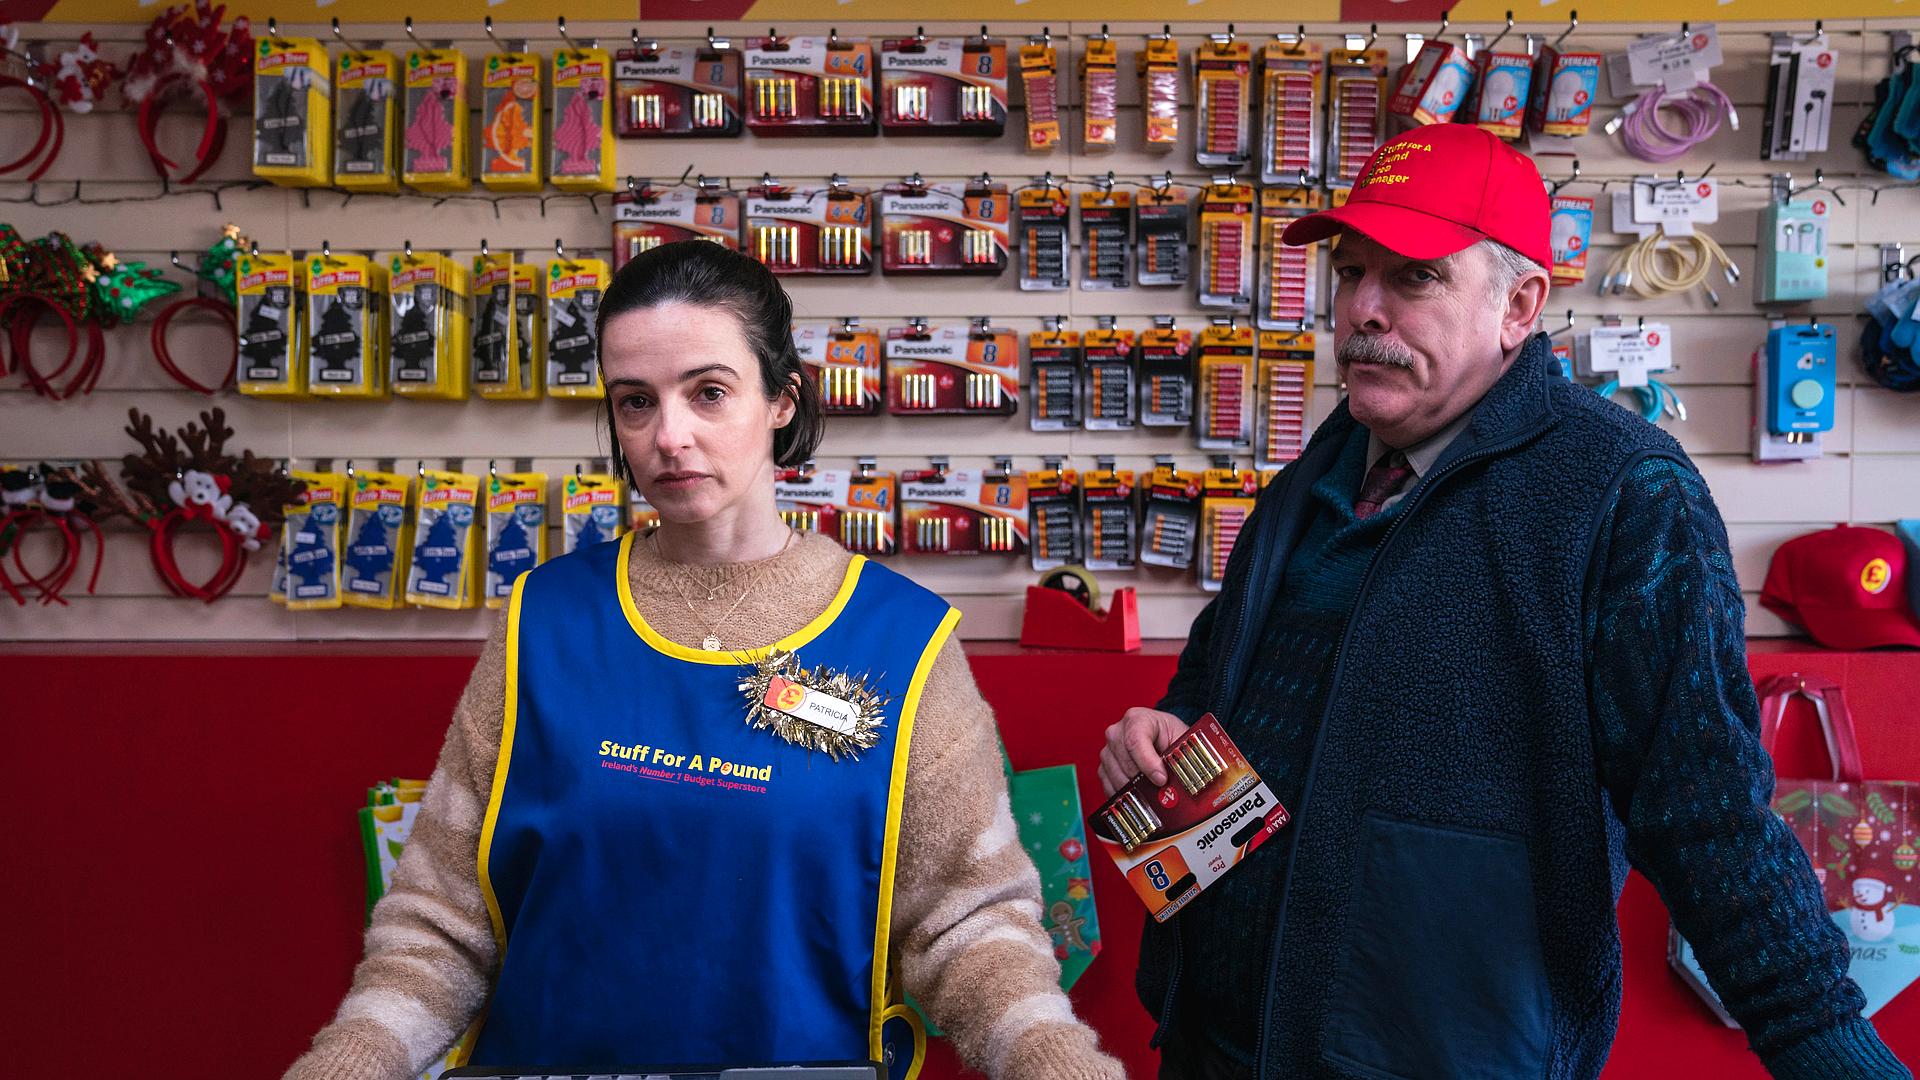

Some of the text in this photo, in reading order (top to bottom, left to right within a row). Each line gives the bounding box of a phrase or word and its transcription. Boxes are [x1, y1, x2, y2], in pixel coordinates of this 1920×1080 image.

[752, 55, 811, 66] Panasonic
[889, 56, 947, 67] Panasonic
[977, 53, 992, 76] 8
[622, 66, 680, 75] Panasonic
[711, 63, 724, 85] 8
[1423, 144, 1432, 152] A
[624, 207, 682, 217] Panasonic
[754, 204, 813, 215] Panasonic
[890, 200, 949, 211] Panasonic
[979, 198, 994, 219] 8
[711, 206, 724, 225] 8
[894, 345, 953, 355] Panasonic
[983, 344, 998, 363] 8
[776, 487, 834, 498] Panasonic
[908, 487, 966, 497] Panasonic
[996, 485, 1011, 506] 8
[809, 702, 848, 722] PATRICIA
[599, 740, 773, 782] Stuff For A Pound
[601, 760, 638, 773] Ireland's
[639, 766, 675, 779] Number
[684, 774, 715, 788] Budget
[717, 779, 767, 794] Superstore
[1226, 776, 1256, 801] ADVANCED
[1107, 815, 1129, 844] Panasonic
[1196, 792, 1266, 851] Panasonic
[1271, 814, 1287, 829] AAA
[1208, 854, 1222, 868] Power
[1212, 860, 1226, 873] Pro
[1144, 859, 1170, 891] 8
